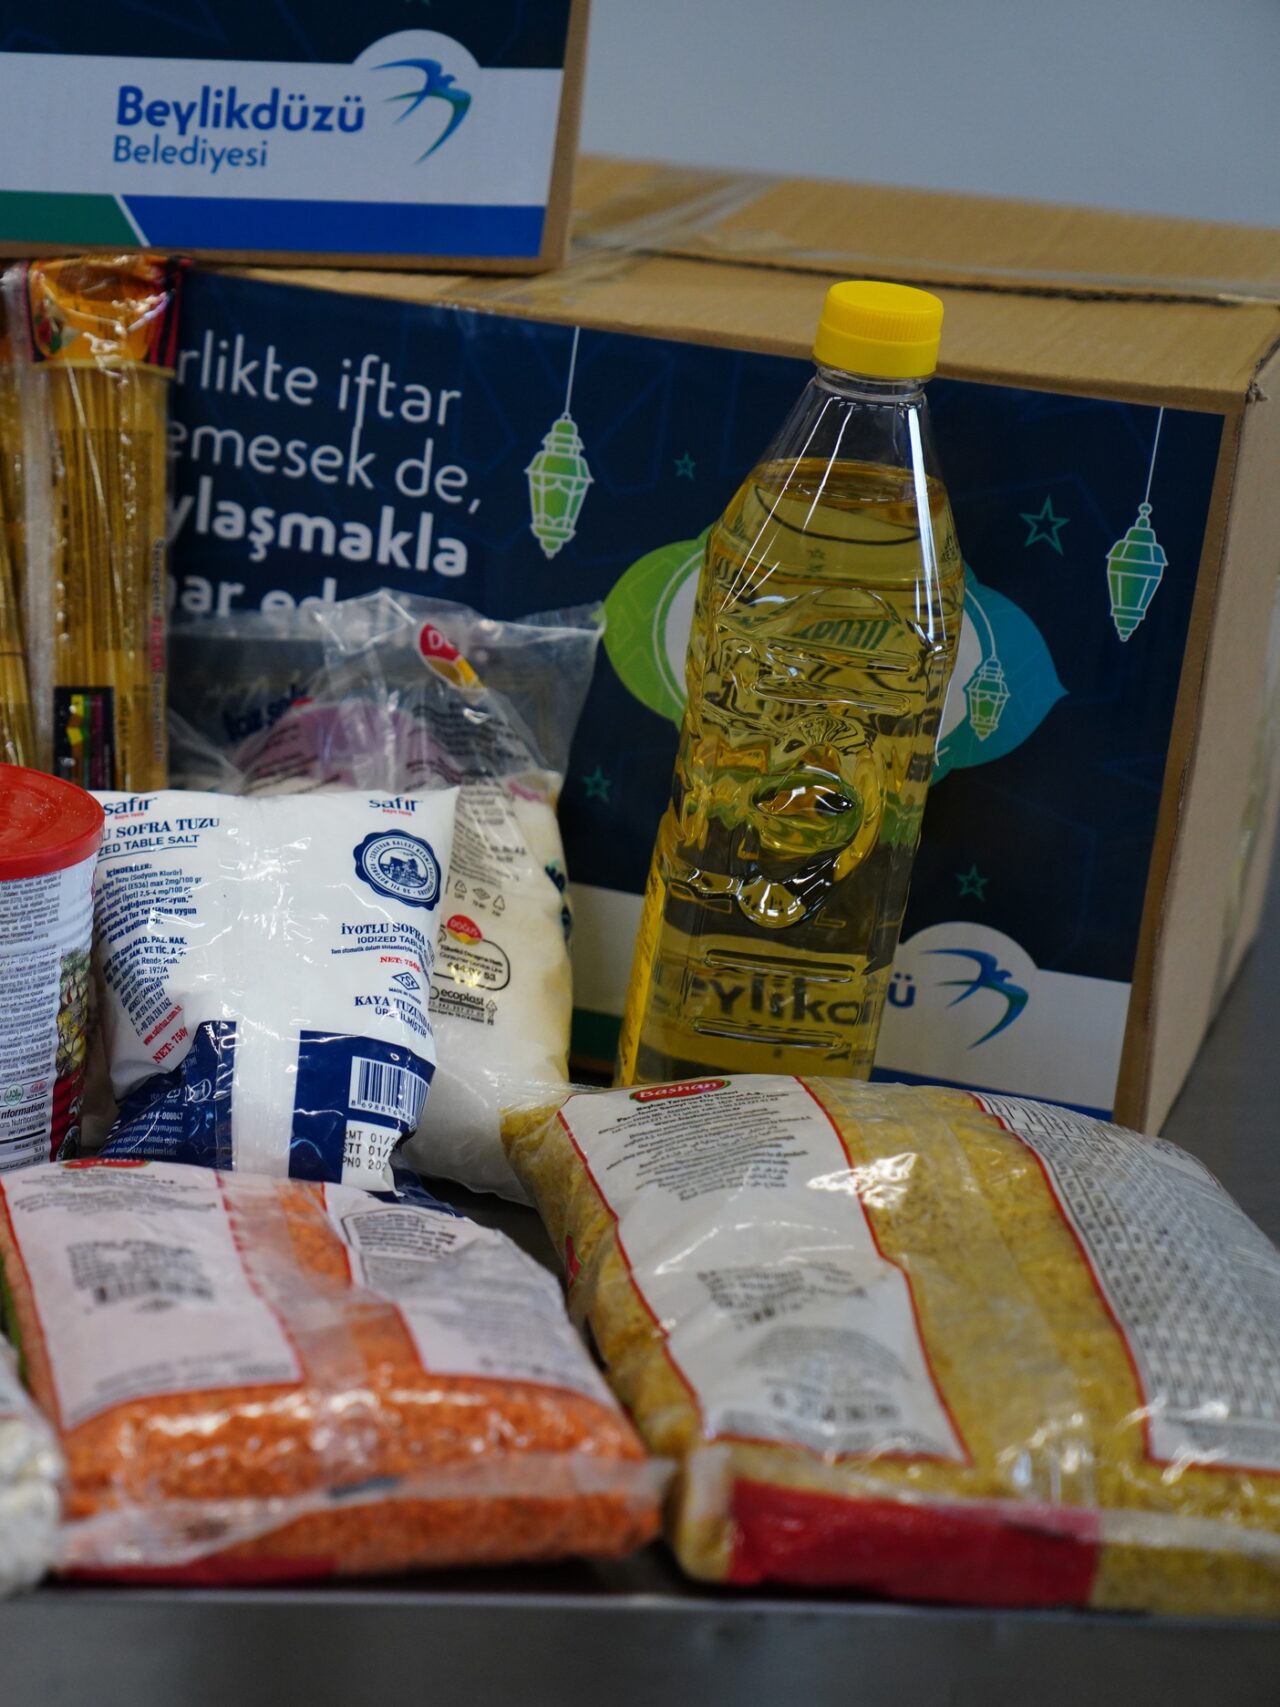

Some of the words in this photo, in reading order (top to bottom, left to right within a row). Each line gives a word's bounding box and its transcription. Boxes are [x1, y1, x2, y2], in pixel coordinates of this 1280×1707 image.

[116, 85, 365, 136] Beylikdüzü
[113, 134, 268, 174] Belediyesi
[177, 329, 319, 406] rlikte
[338, 353, 462, 430] iftar
[166, 420, 376, 490] emesek
[395, 437, 481, 515] de,
[166, 475, 469, 578] ylaşmakla
[103, 796, 154, 817] safir
[368, 796, 420, 812] safir
[115, 820, 172, 839] SOFRA
[175, 817, 220, 831] TUZU
[124, 836, 164, 851] TABLE
[167, 834, 200, 845] SALT
[174, 907, 197, 917] uygun
[340, 922, 390, 935] İYOTLU
[357, 935, 397, 944] IODIZED
[144, 946, 154, 954] VE
[380, 956, 403, 964] NET:
[354, 995, 390, 1007] KAYA
[441, 987, 485, 1006] ecoplast
[152, 1042, 175, 1064] NET:
